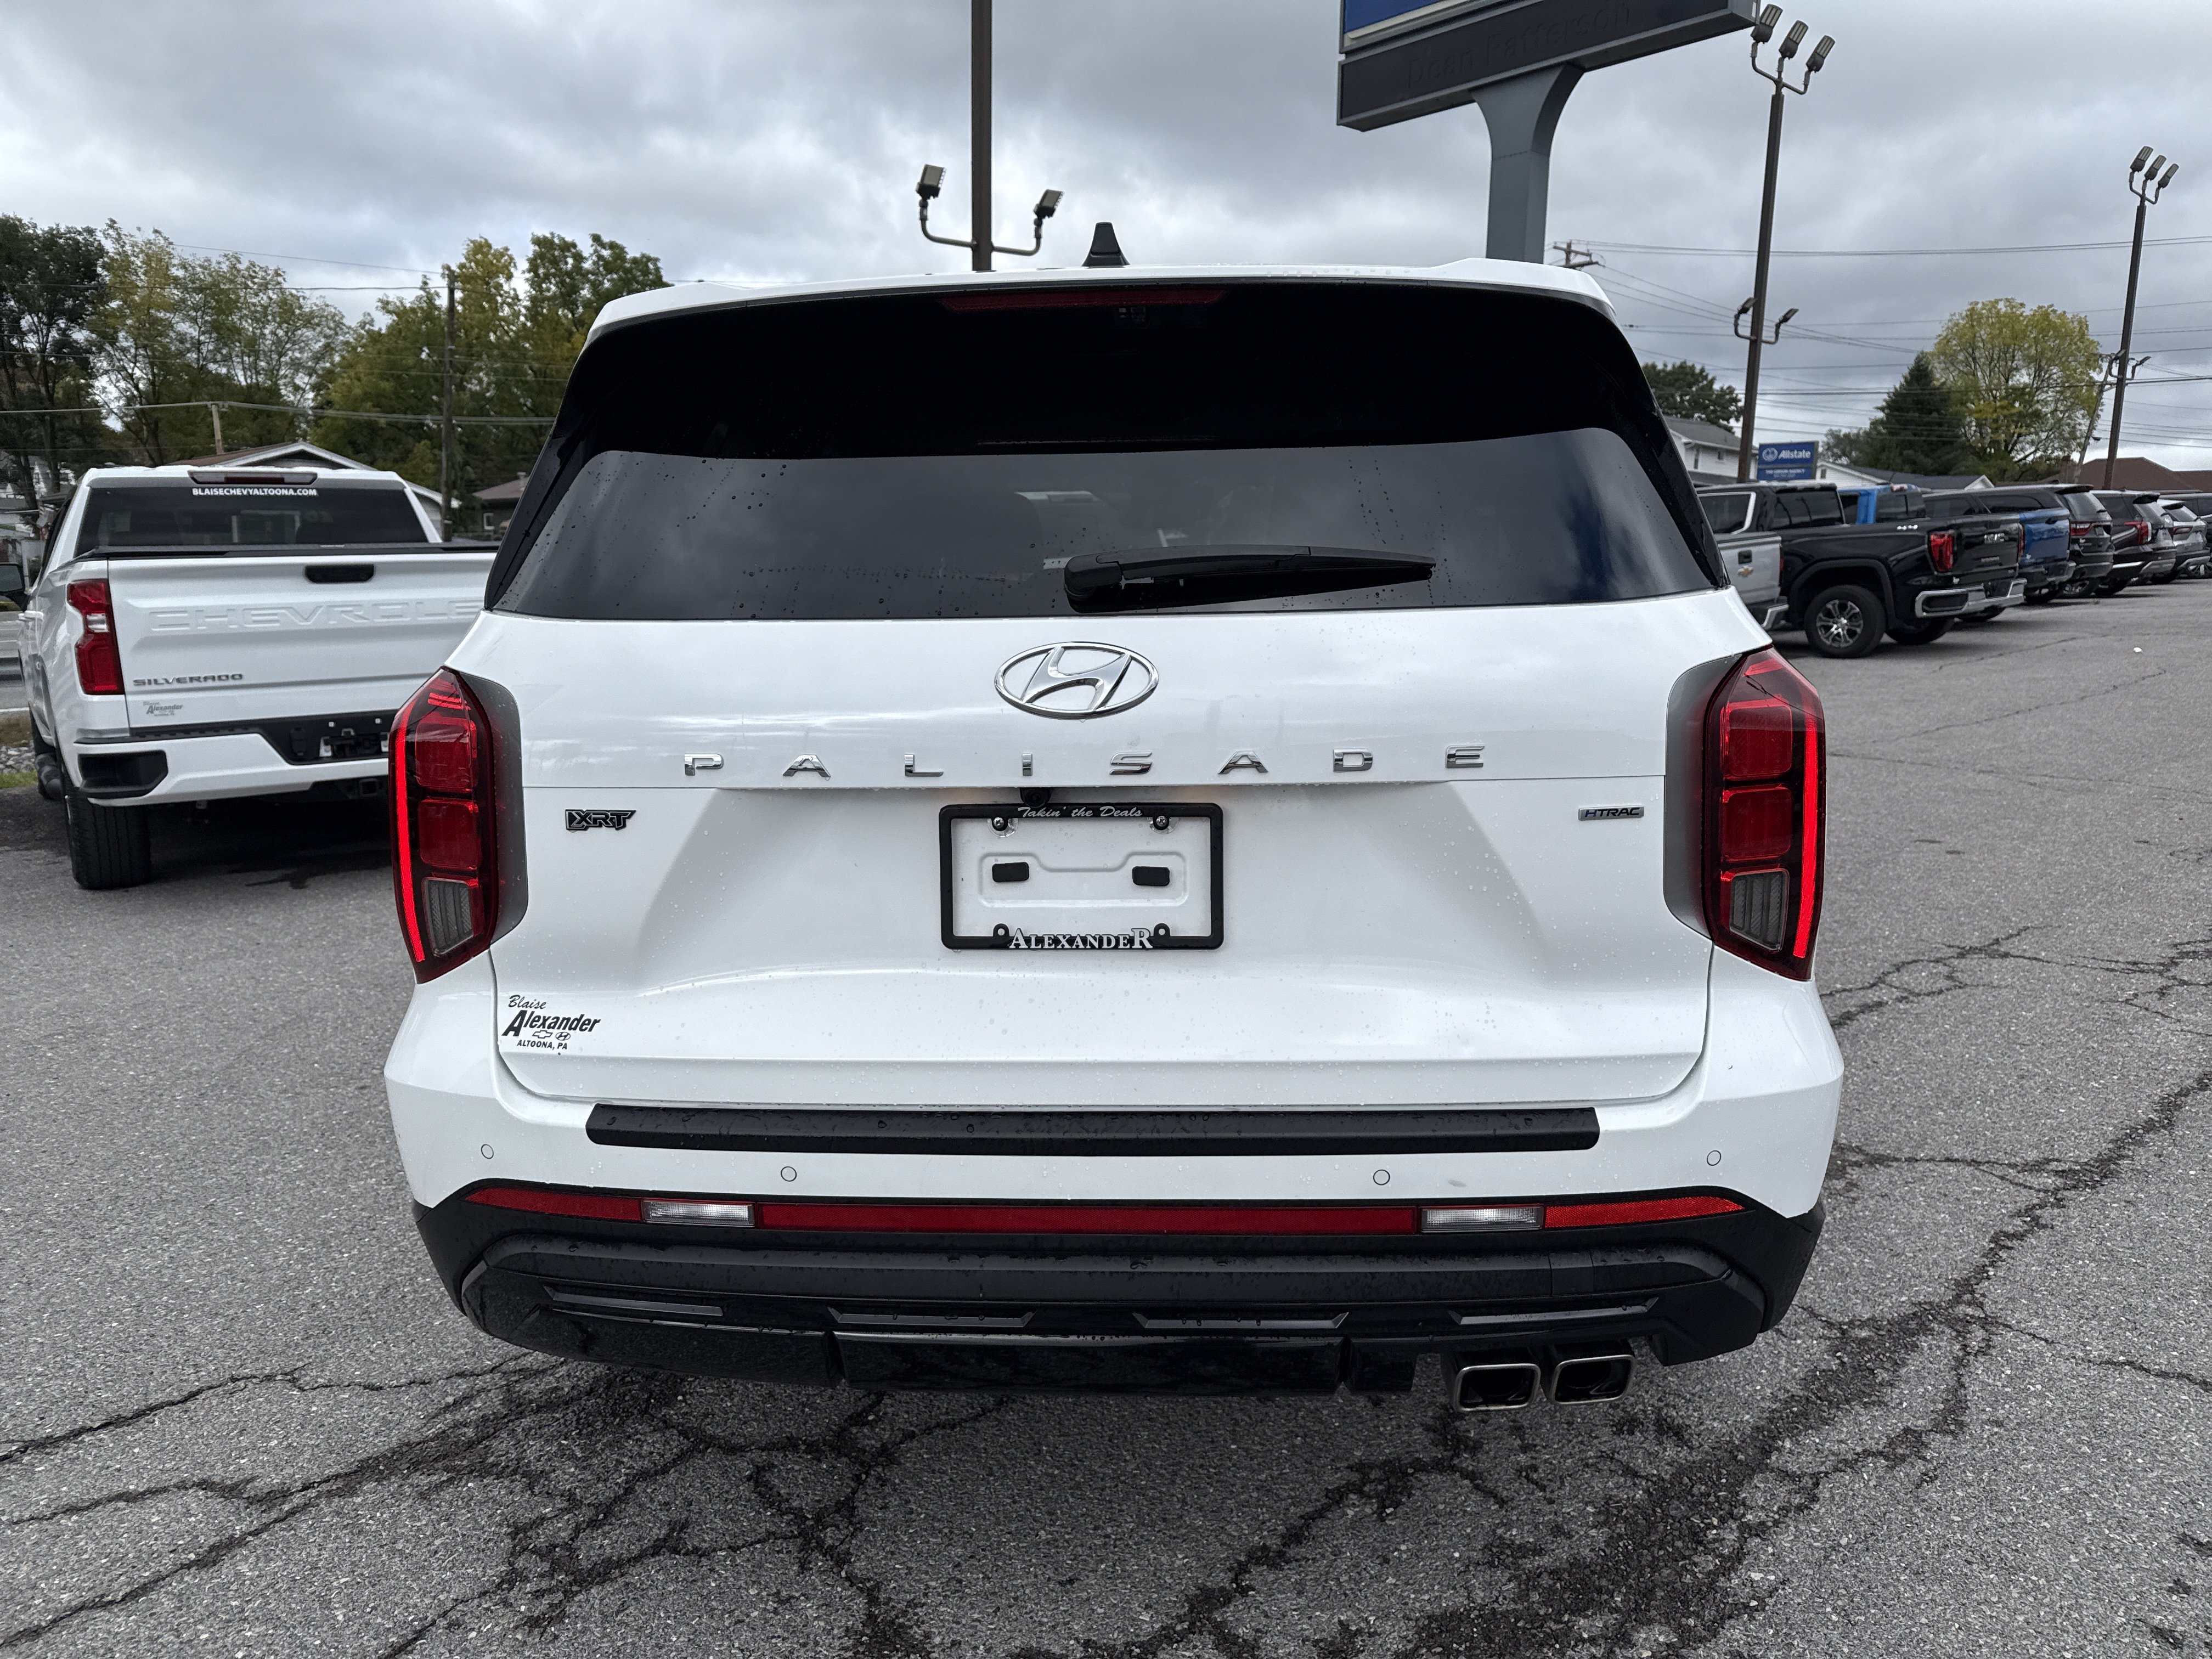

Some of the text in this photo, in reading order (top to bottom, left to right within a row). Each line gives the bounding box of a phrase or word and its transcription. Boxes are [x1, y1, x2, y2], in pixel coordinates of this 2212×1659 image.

[1778, 449, 1811, 459] Allstate
[192, 488, 317, 496] BLAISECHEVYALTOONA.COM
[149, 600, 484, 631] CHEVROLE
[133, 673, 243, 686] SILVERADO
[146, 704, 183, 714] Alexander
[684, 745, 1485, 777] PALISADE
[1018, 806, 1143, 818] Takin' the Deals
[1584, 807, 1640, 818] HTRAC
[566, 809, 635, 830] XRT
[508, 994, 546, 1009] Blaise
[501, 1009, 601, 1037] Alexander
[517, 1039, 555, 1050] ALTOONA,
